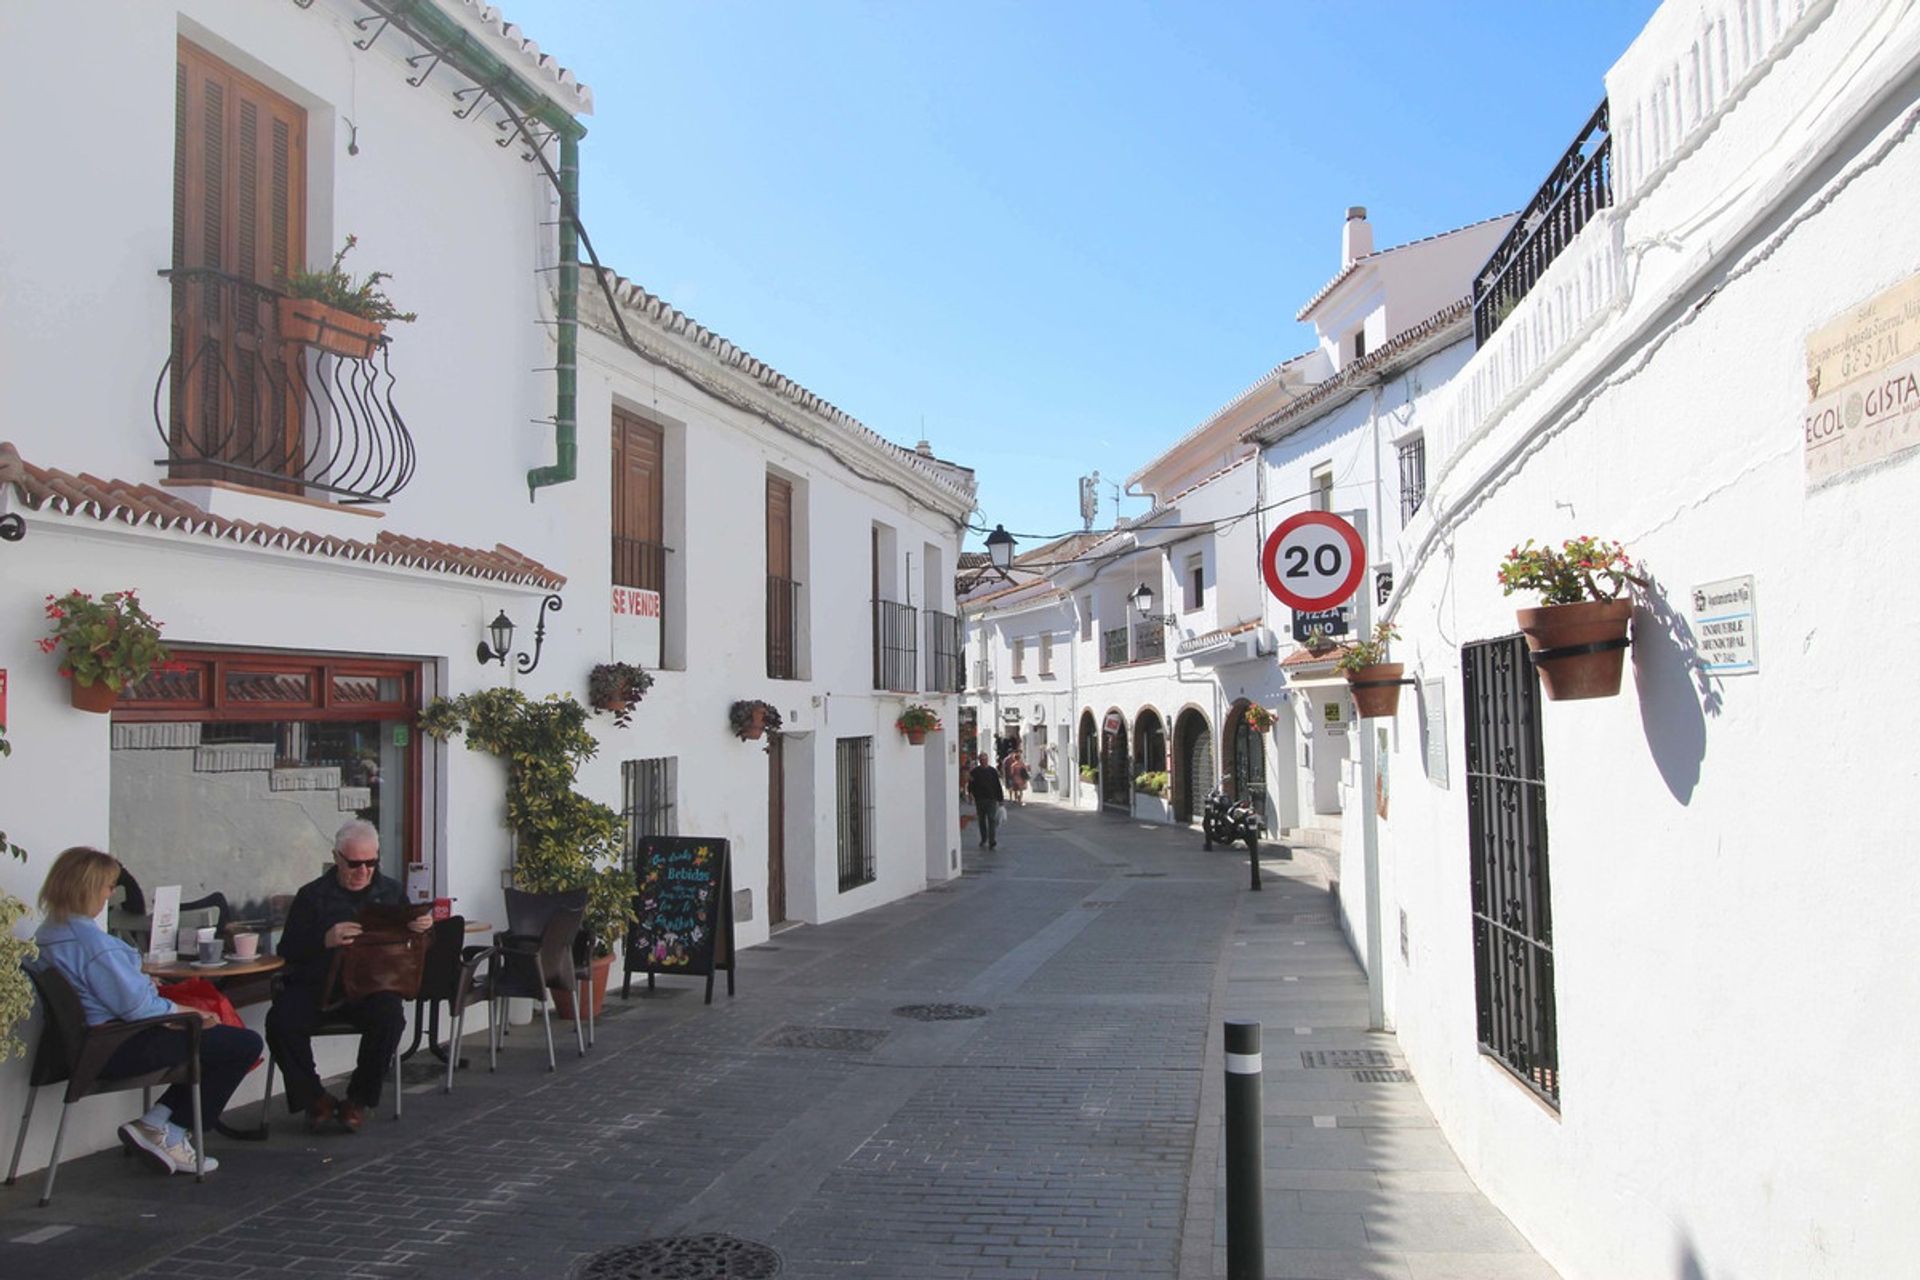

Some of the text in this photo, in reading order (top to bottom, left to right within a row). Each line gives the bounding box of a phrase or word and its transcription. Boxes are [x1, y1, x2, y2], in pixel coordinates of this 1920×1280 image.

[1284, 543, 1342, 578] 20
[612, 588, 660, 618] SE VENDE
[1296, 608, 1340, 620] PIZZA
